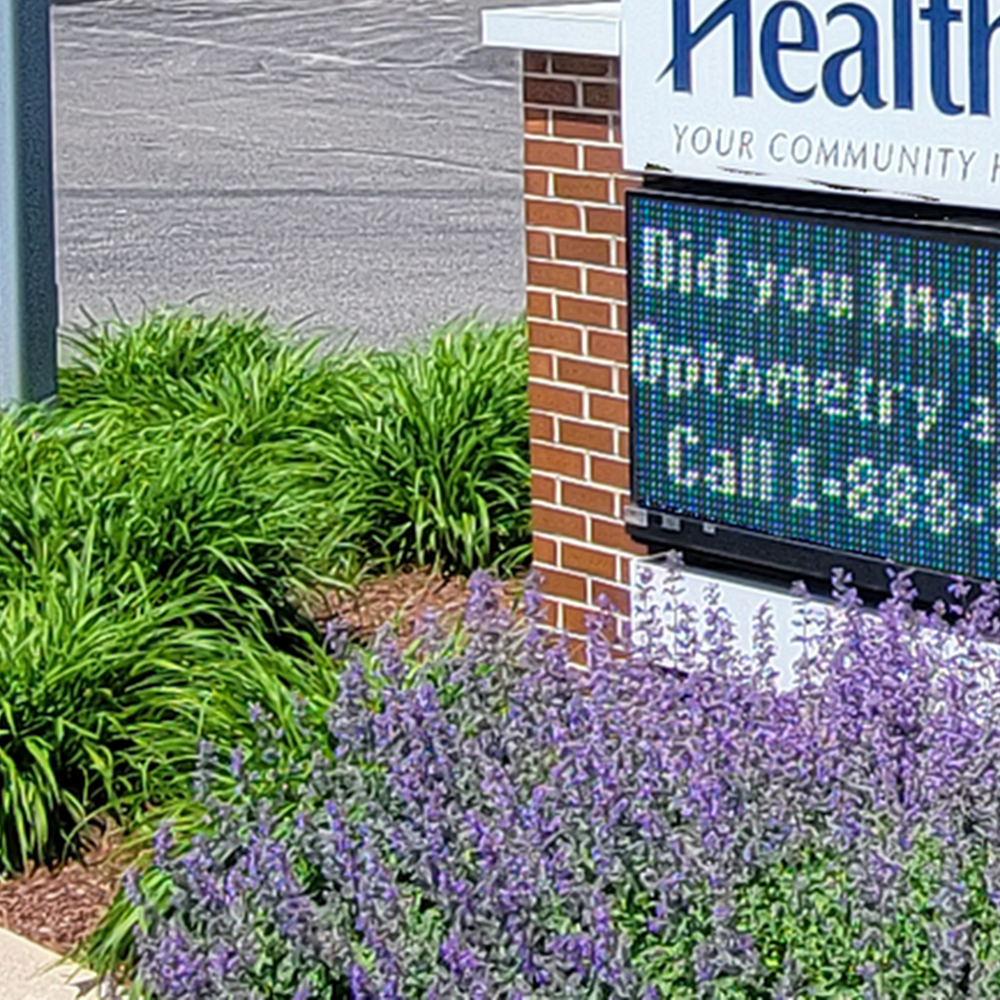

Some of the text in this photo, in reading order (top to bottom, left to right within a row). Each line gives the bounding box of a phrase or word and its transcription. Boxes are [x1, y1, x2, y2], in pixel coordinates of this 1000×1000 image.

[673, 123, 754, 160] YOUR
[768, 132, 977, 182] COMMUNITY
[642, 225, 730, 299] Did
[746, 259, 853, 320] you
[631, 321, 944, 441] Optometry
[667, 423, 773, 503] Call
